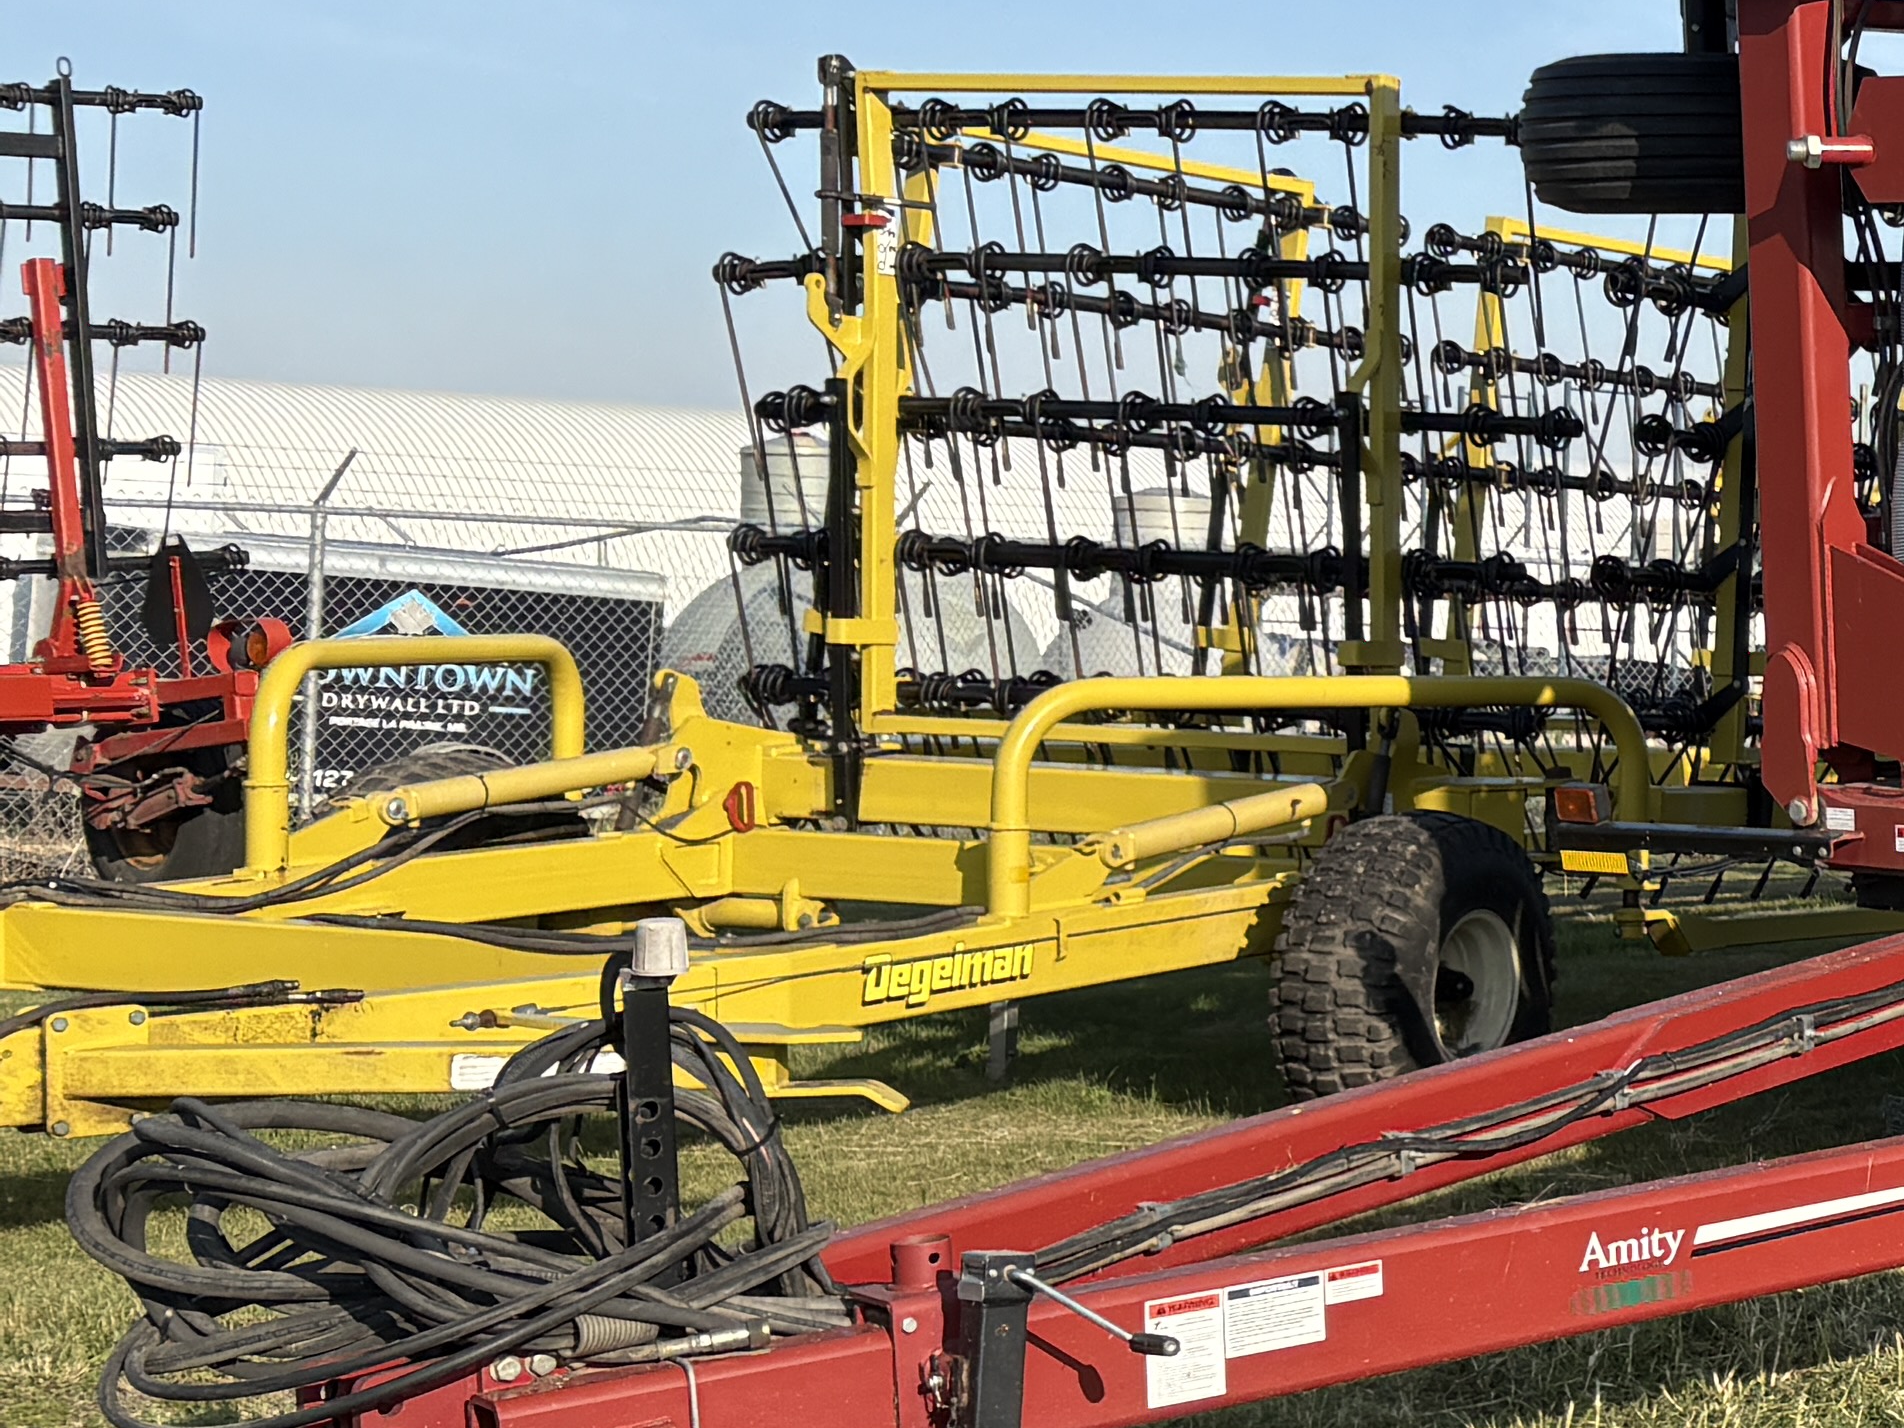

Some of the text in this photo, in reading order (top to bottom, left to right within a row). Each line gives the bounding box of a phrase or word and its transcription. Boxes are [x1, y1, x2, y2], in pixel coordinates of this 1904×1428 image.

[318, 664, 537, 697] WNTOWN
[321, 692, 480, 716] DRYWALL LTD
[862, 941, 1034, 1008] Degelman
[1579, 1227, 1686, 1272] Amity
